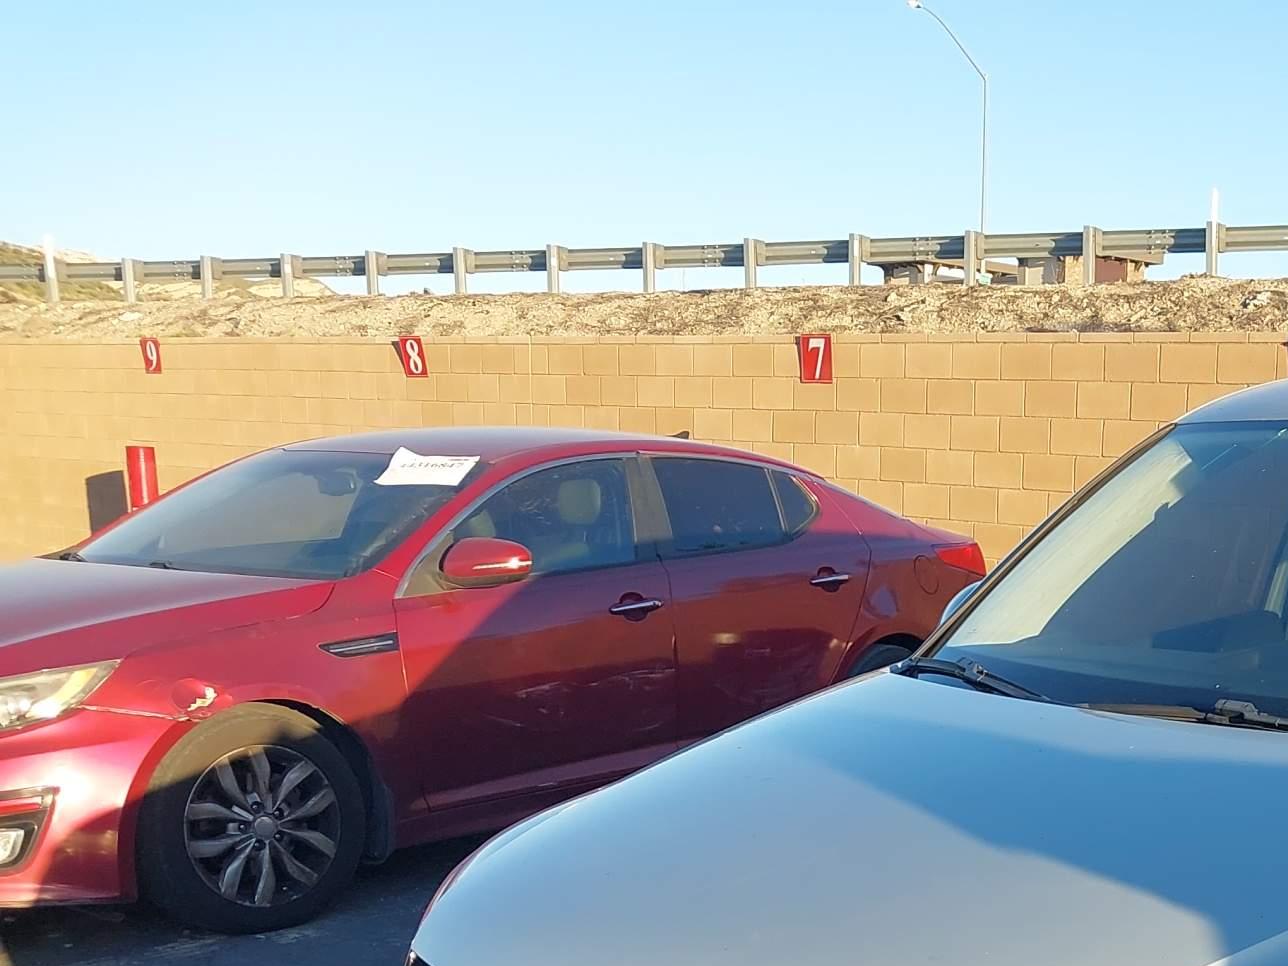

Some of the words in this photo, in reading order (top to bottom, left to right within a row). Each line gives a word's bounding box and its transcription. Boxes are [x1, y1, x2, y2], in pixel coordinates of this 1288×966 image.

[146, 340, 157, 371] 9
[405, 339, 423, 374] 8
[807, 338, 826, 380] 7
